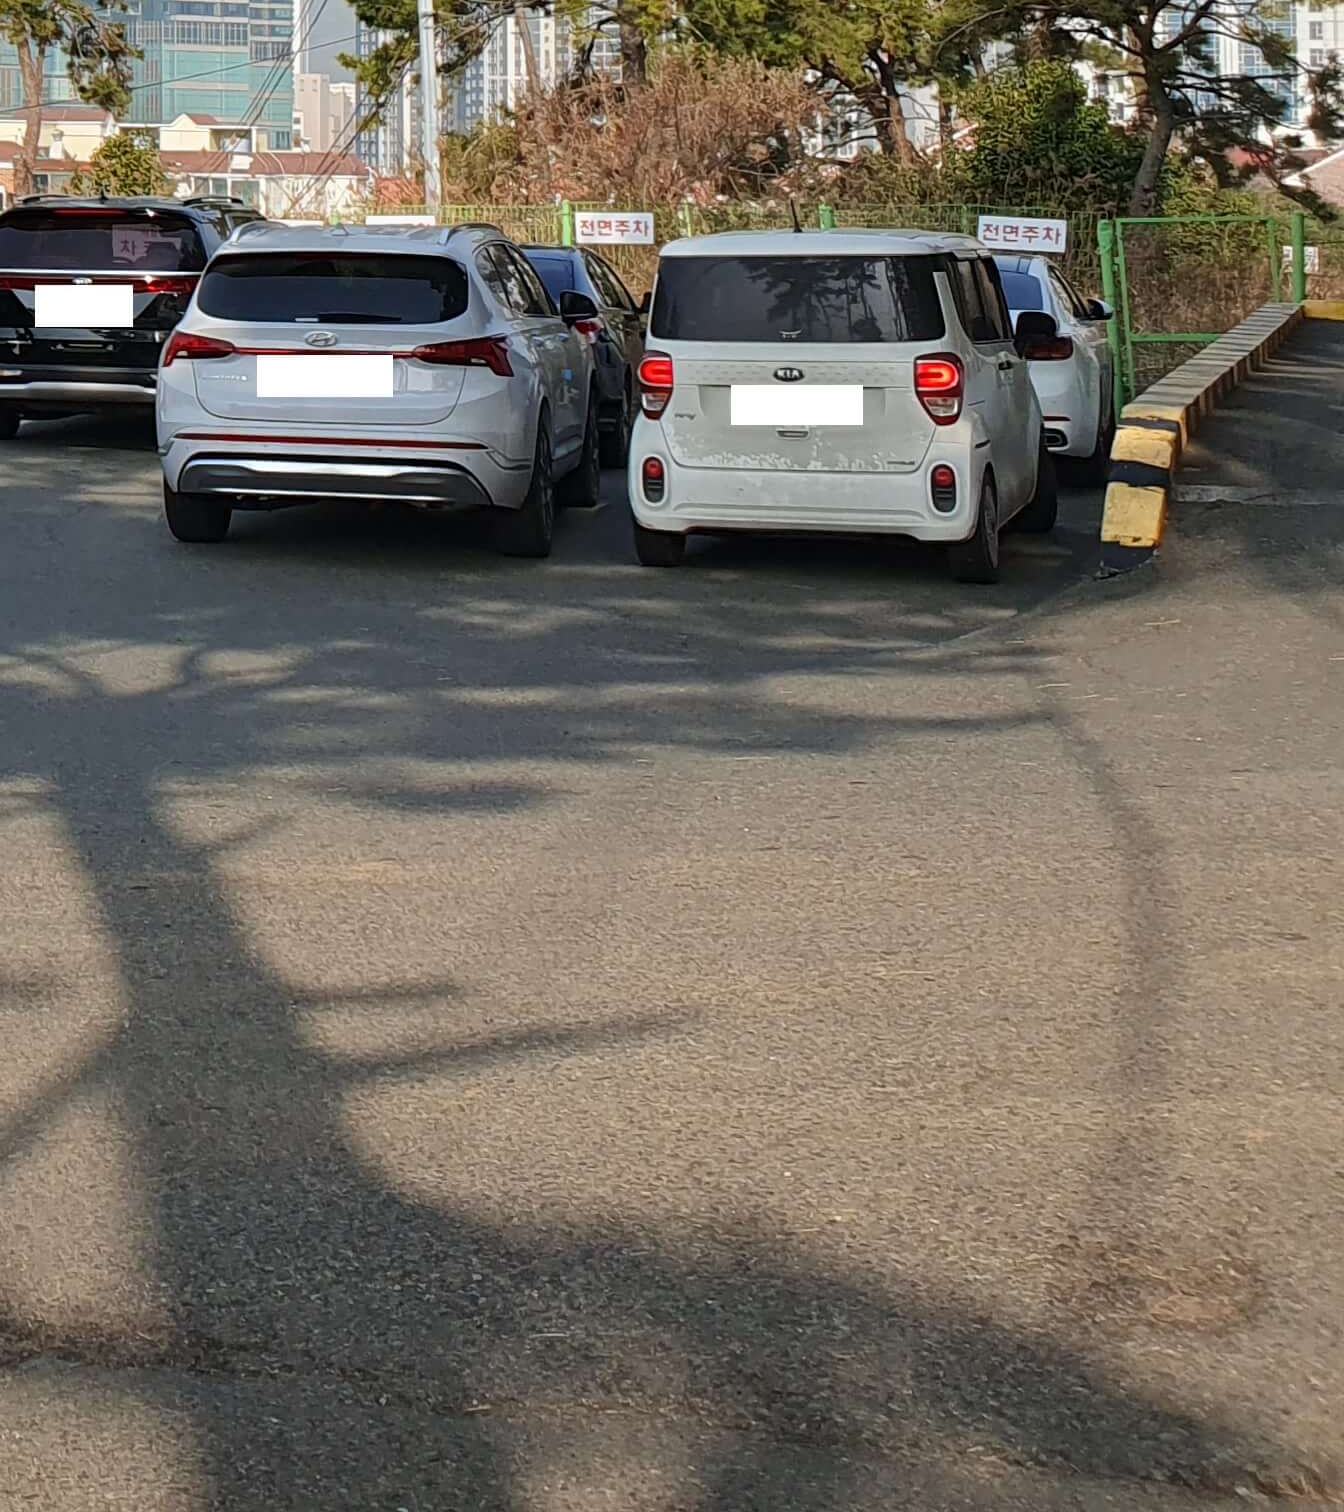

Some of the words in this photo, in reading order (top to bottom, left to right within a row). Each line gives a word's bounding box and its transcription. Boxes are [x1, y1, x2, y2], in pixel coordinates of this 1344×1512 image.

[579, 219, 649, 237] 전면주차
[982, 223, 1062, 245] 전면주차
[777, 369, 800, 378] KIA
